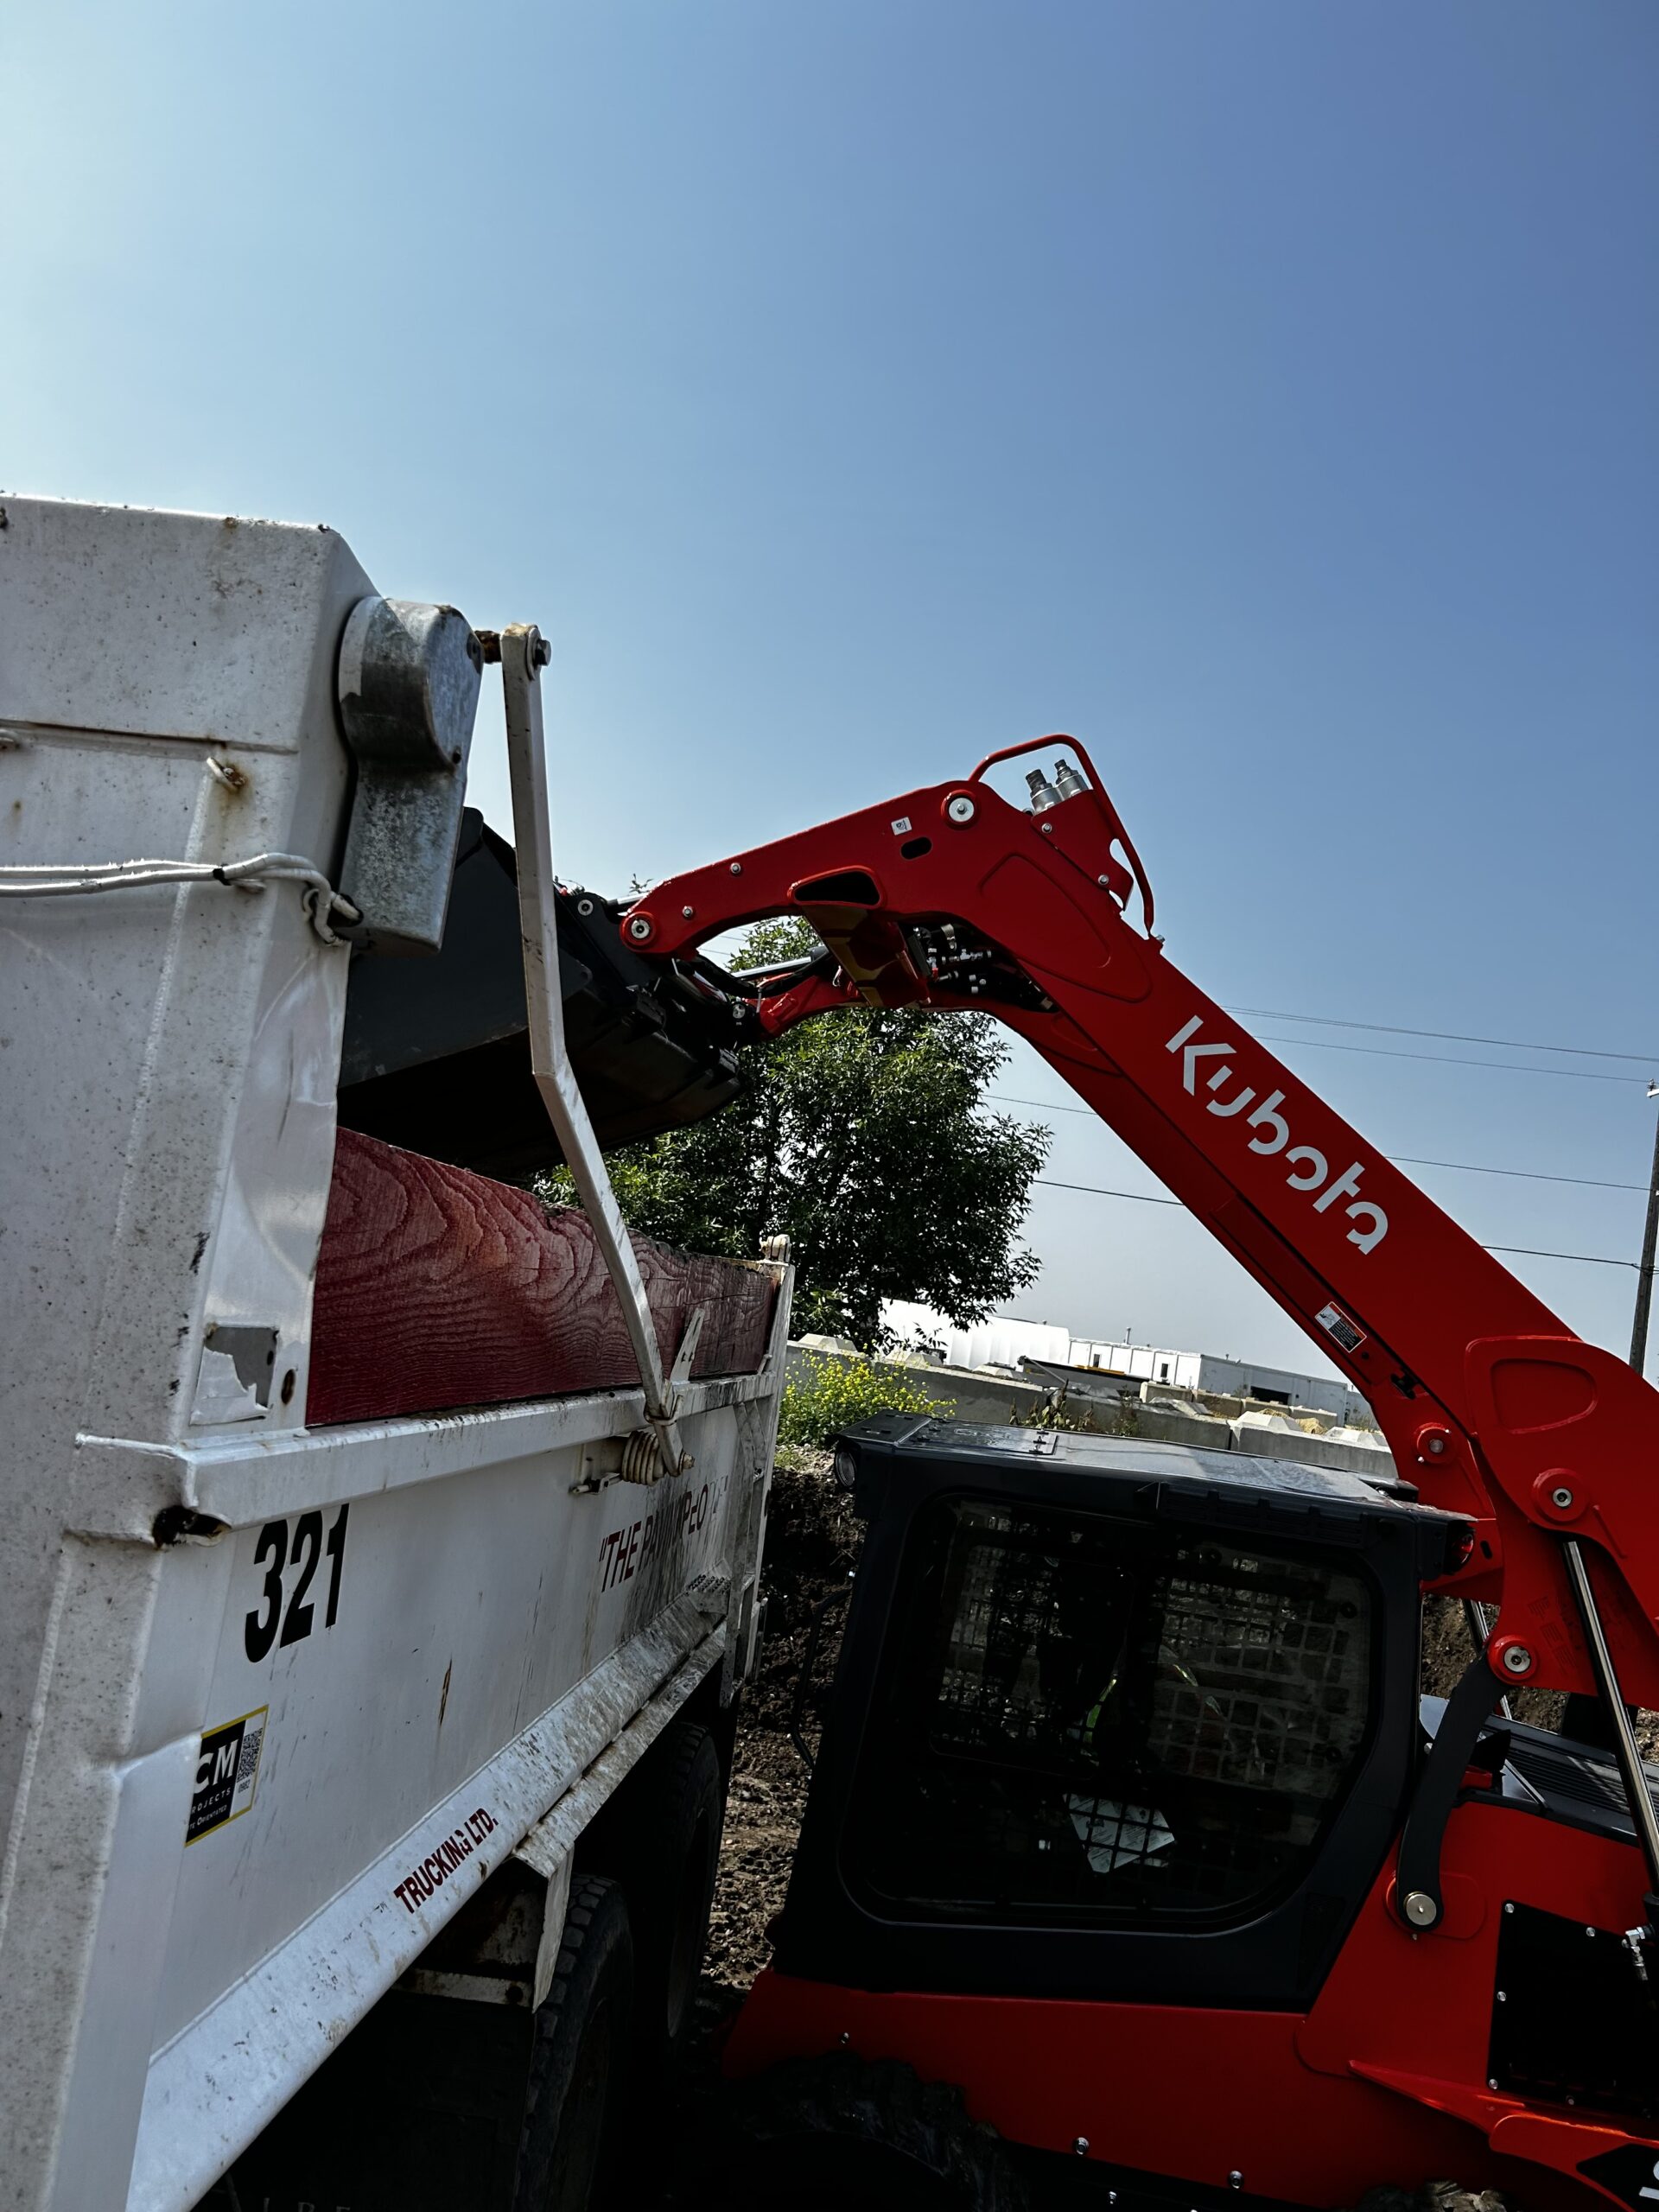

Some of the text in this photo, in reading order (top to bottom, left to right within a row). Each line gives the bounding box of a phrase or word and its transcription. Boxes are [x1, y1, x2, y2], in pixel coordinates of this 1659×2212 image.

[1165, 1014, 1389, 1255] Kubota
[244, 1503, 350, 1664] 321
[192, 1787, 232, 1815] ROJECTS
[393, 1808, 499, 1914] TRUCKING LTD.
